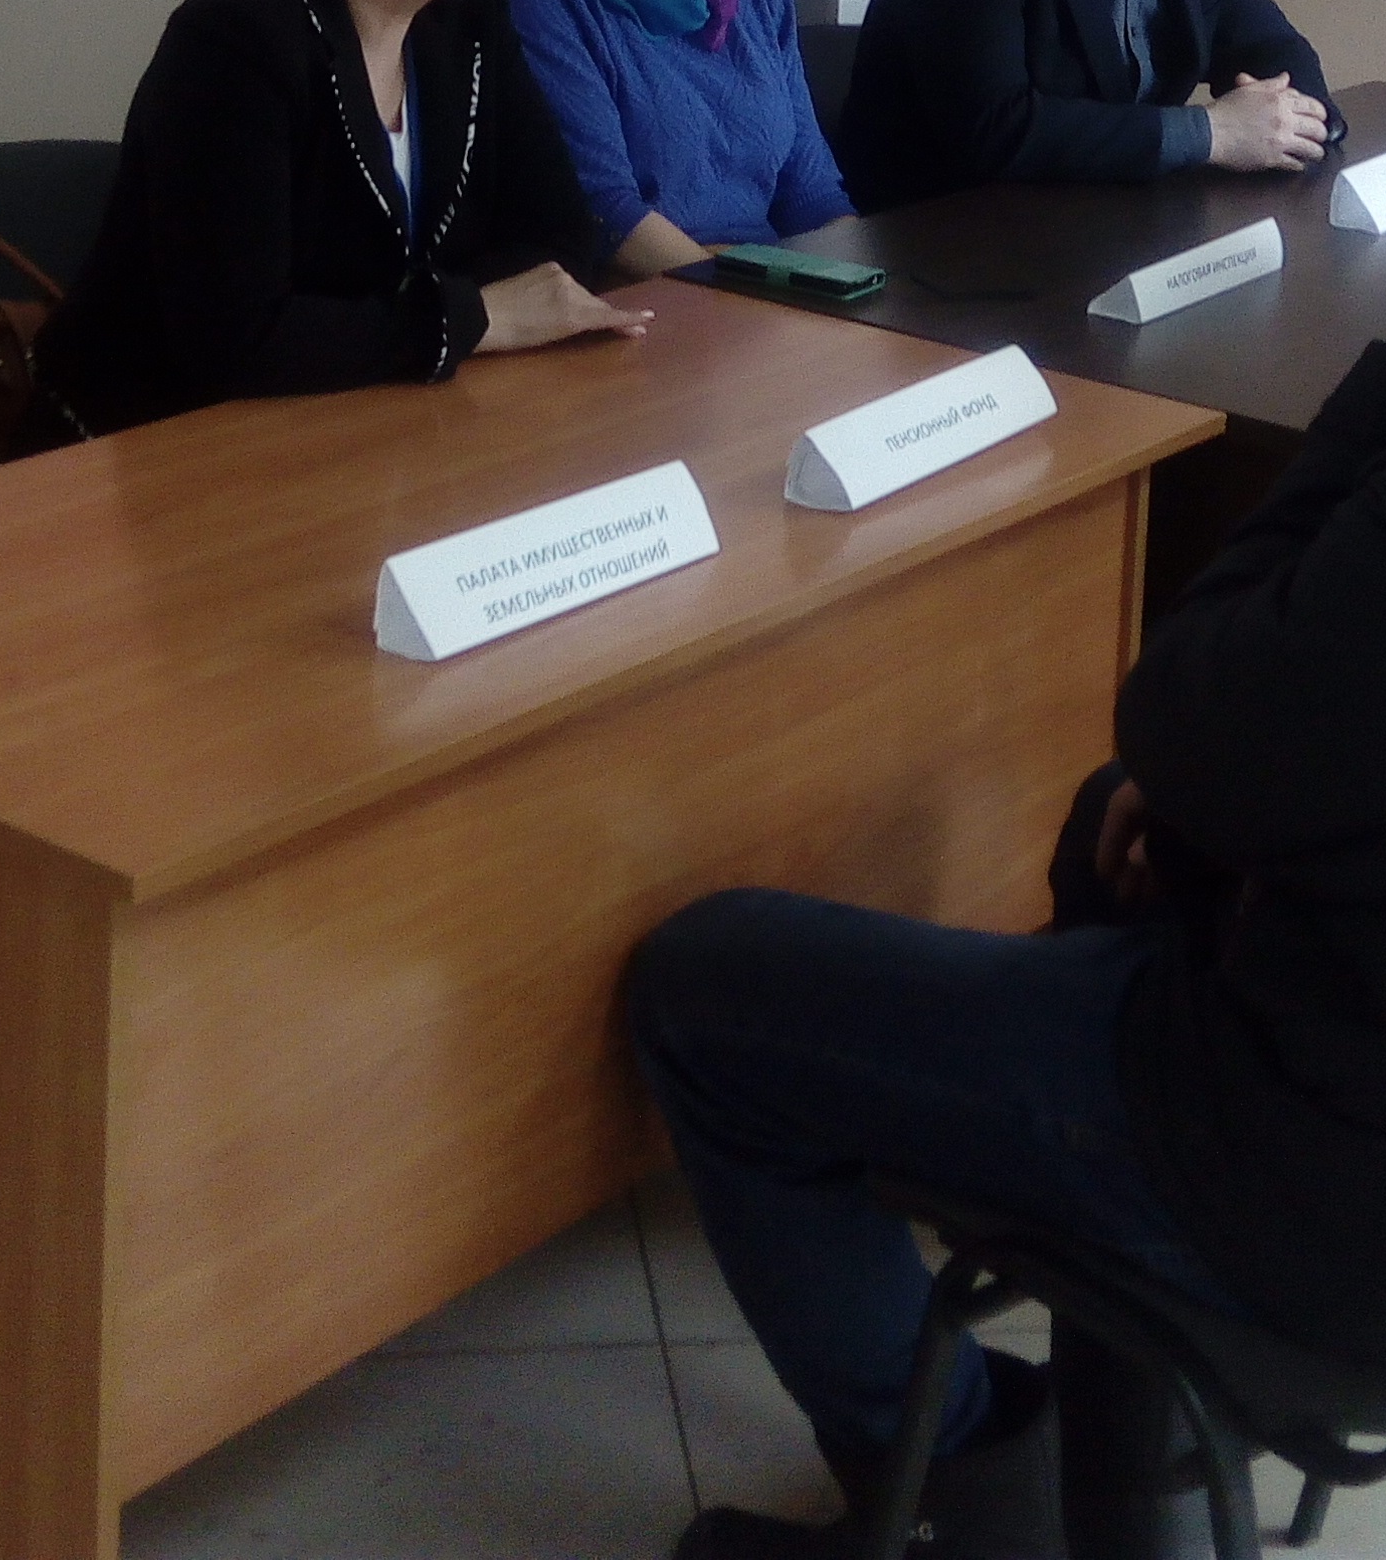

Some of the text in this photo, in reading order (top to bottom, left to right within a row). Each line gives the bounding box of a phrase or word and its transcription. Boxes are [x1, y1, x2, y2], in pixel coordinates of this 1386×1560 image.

[885, 393, 999, 452] ПЕНСИОННЫЙ ФОНД
[456, 504, 669, 595] ПАЛАТА ИМУЩЕСТВЕННЫХ И
[483, 539, 670, 624] ЗЕМЕЛЬНЫХ ОТНОШЕНИЙ
